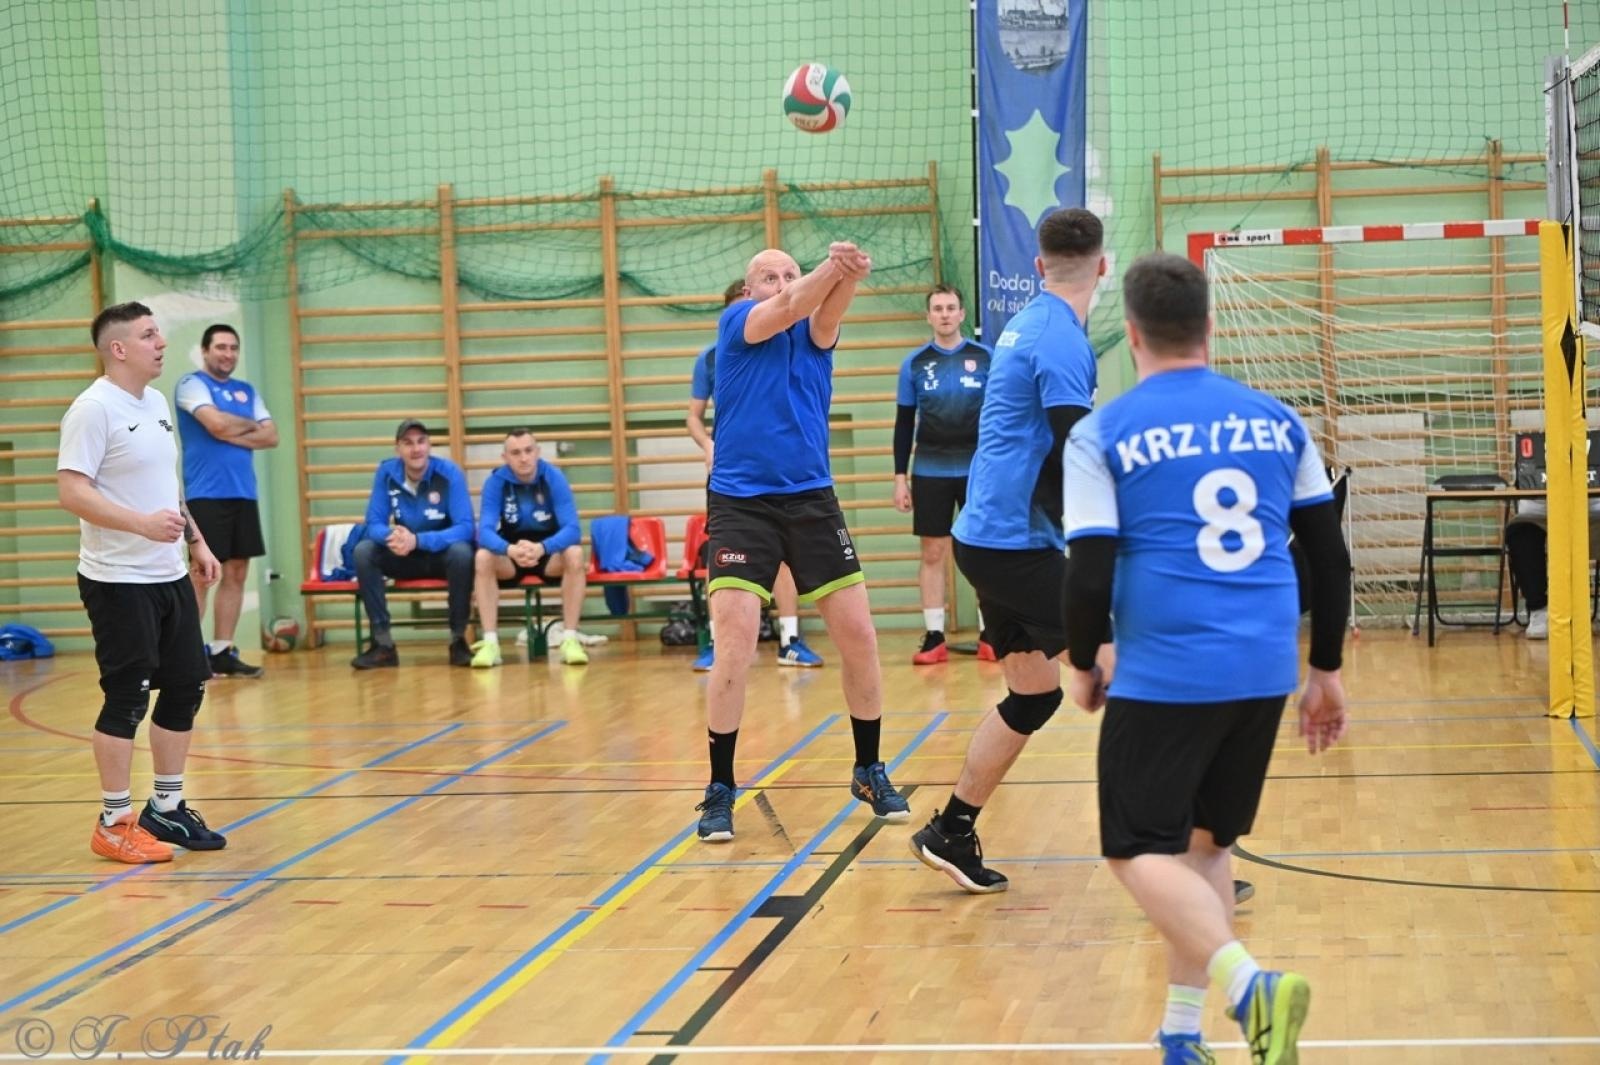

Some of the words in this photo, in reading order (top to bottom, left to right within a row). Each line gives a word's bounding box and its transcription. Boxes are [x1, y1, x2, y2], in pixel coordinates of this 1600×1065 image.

[989, 270, 1036, 297] Dodaj
[987, 294, 1006, 313] od
[1193, 467, 1266, 573] 8
